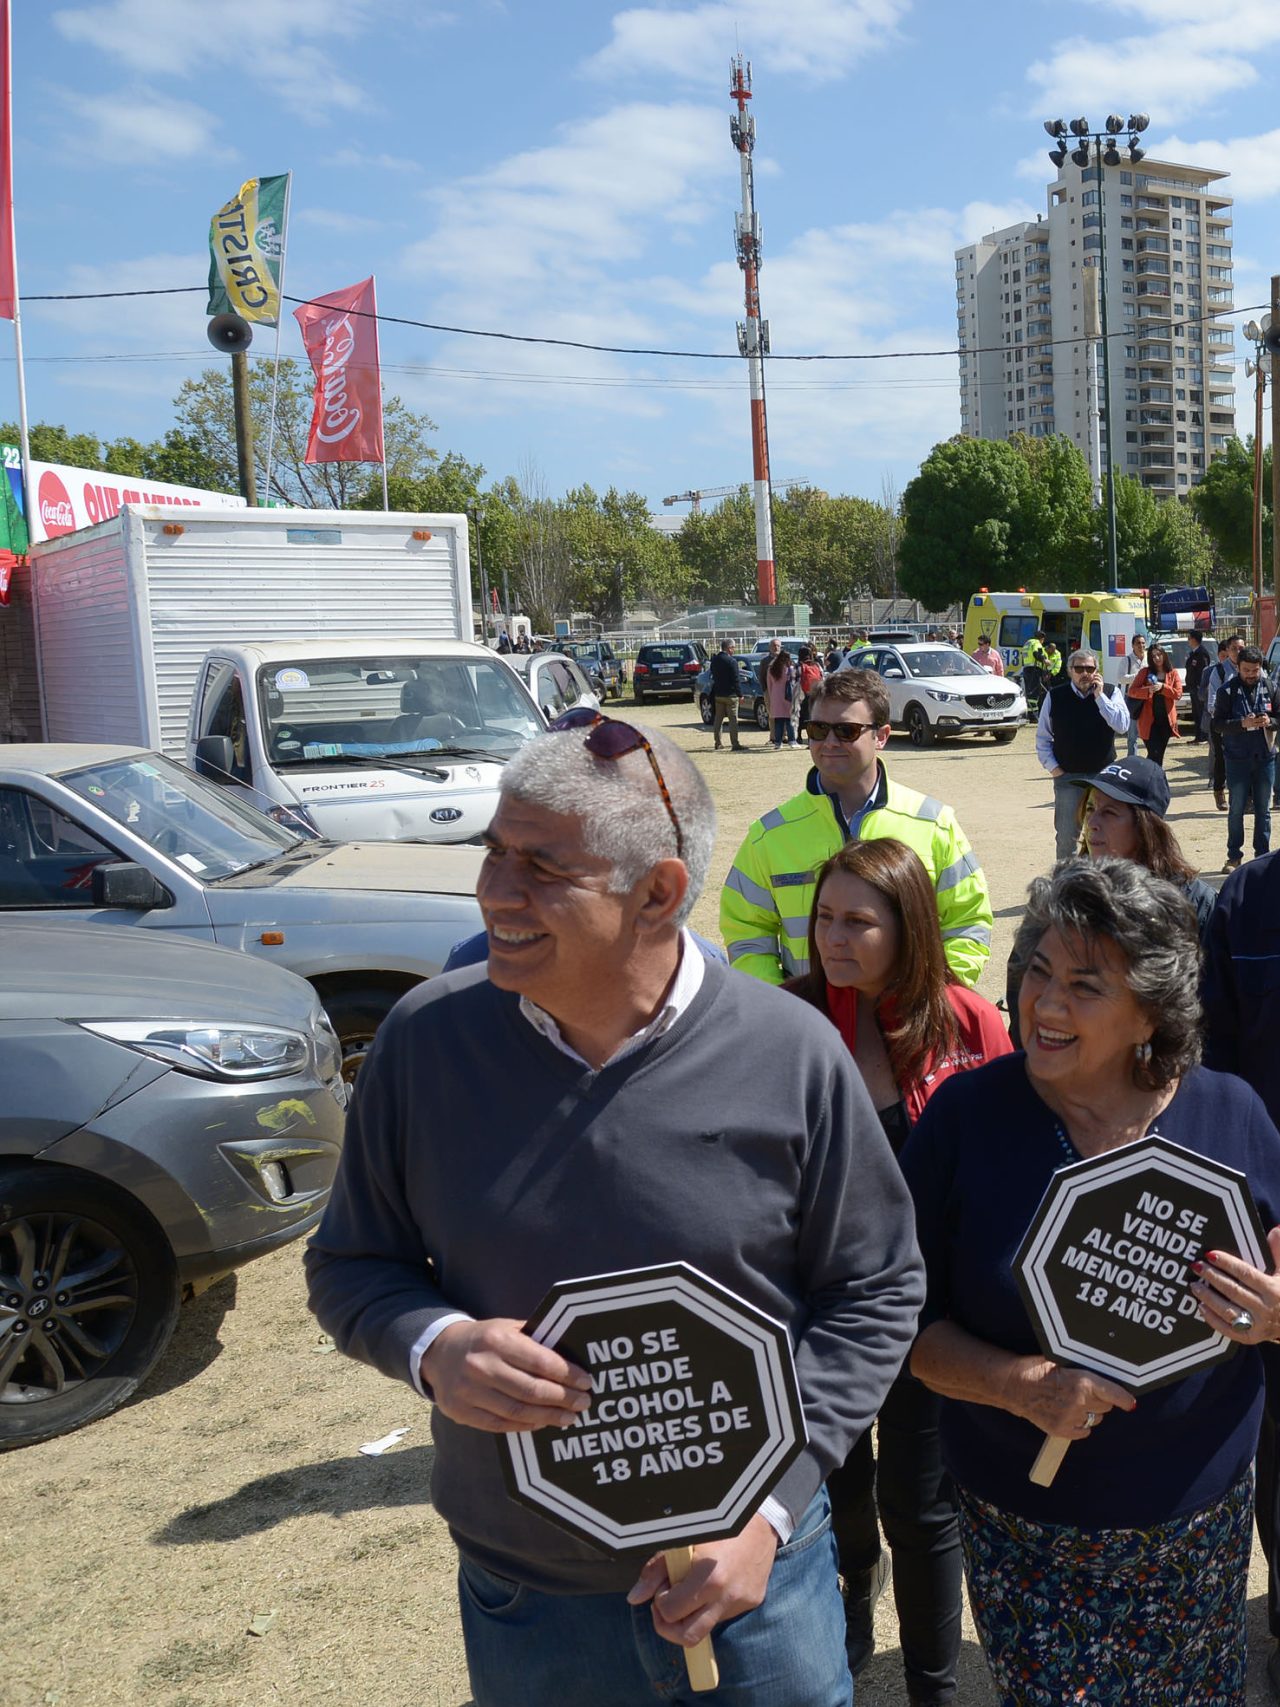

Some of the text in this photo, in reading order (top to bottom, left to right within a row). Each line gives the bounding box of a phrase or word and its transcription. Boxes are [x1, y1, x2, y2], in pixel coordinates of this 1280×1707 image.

[303, 782, 368, 793] FRONTIER
[435, 810, 458, 820] KIA
[1122, 1212, 1202, 1261] VENDE
[1136, 1191, 1208, 1236] NO SE
[1060, 1245, 1177, 1304] MENORES
[1082, 1227, 1189, 1287] ALCOHOL
[1075, 1281, 1178, 1336] 18 AÑOS
[586, 1328, 680, 1365] NO SE
[589, 1356, 693, 1394] VENDE
[559, 1380, 733, 1431] ALCOHOL A
[551, 1406, 752, 1462] MENORES DE
[592, 1441, 725, 1485] 18 AÑOS
